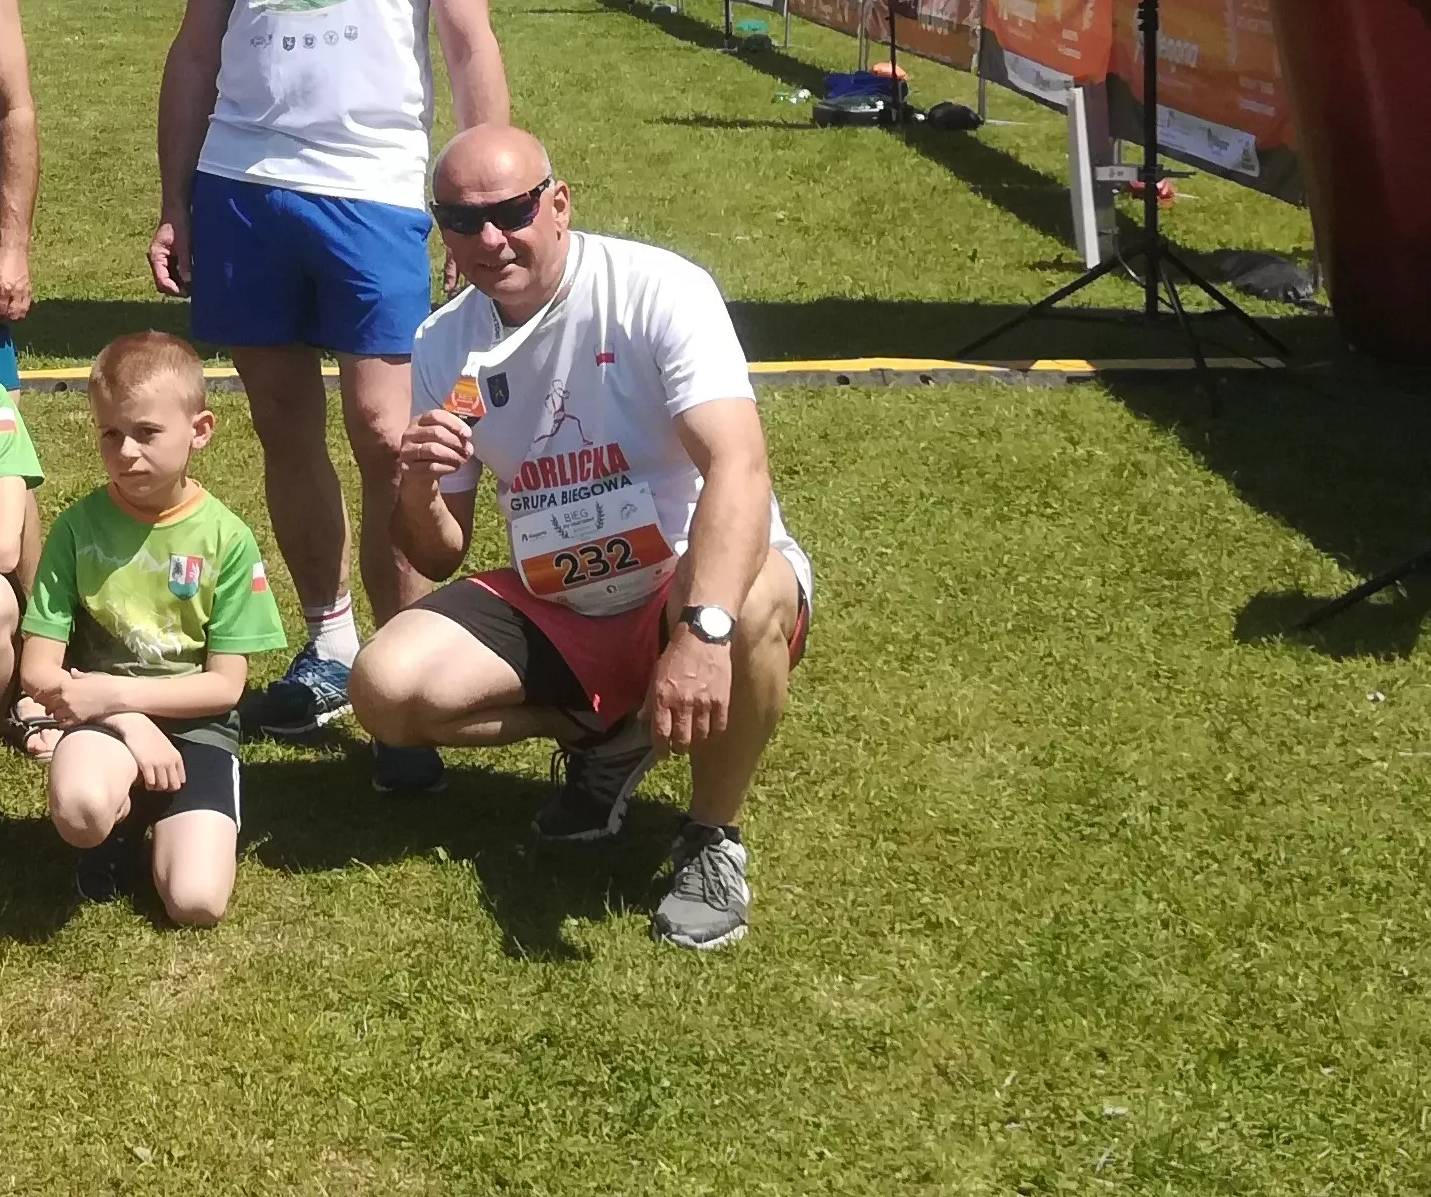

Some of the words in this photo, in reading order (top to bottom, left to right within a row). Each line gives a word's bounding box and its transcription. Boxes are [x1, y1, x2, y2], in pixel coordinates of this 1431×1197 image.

[510, 490, 558, 512] GRUPA
[561, 474, 633, 505] BIEGOWA
[563, 508, 589, 522] BIEG
[553, 537, 641, 585] 232
